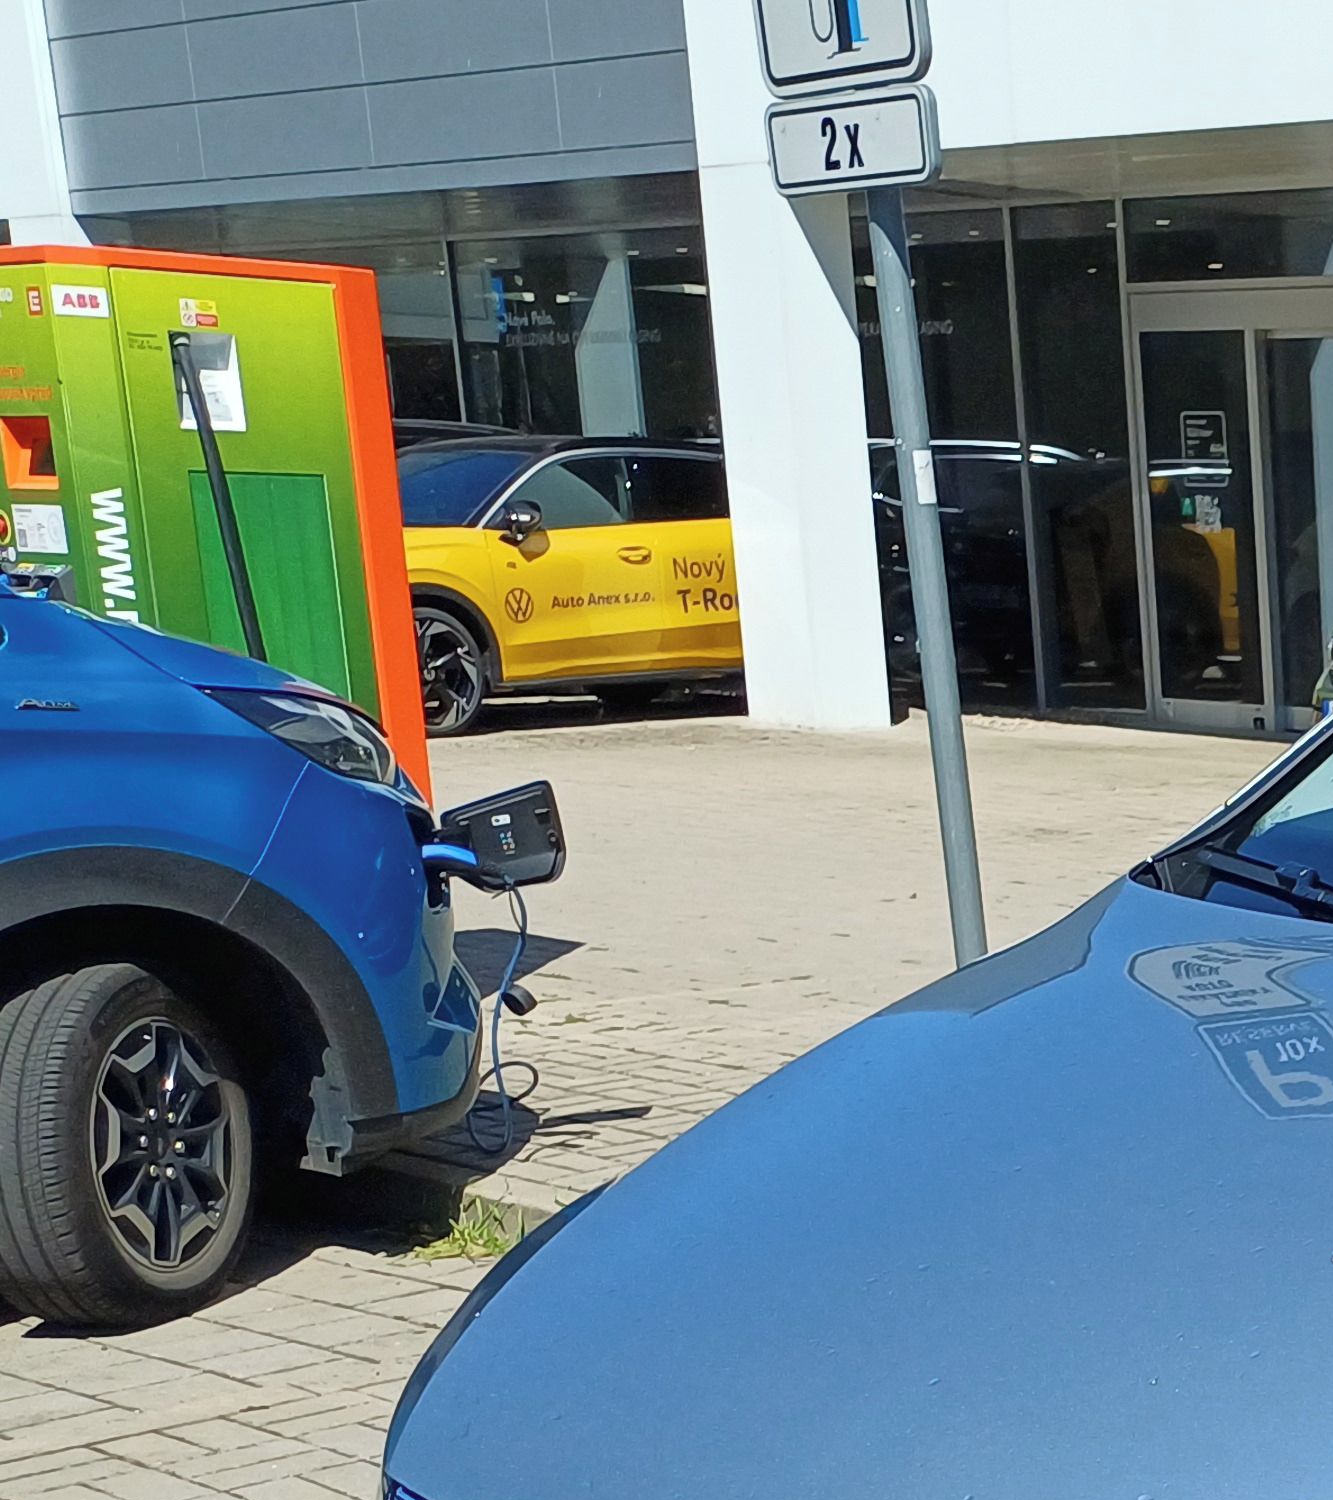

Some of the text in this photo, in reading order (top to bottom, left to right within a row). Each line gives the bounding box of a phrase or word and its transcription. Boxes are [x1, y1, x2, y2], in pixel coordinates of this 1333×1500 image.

[61, 292, 101, 309] ABB
[90, 487, 139, 623] www.
[673, 553, 725, 583] Nový
[551, 592, 655, 609] Auto Anex s.r.o.
